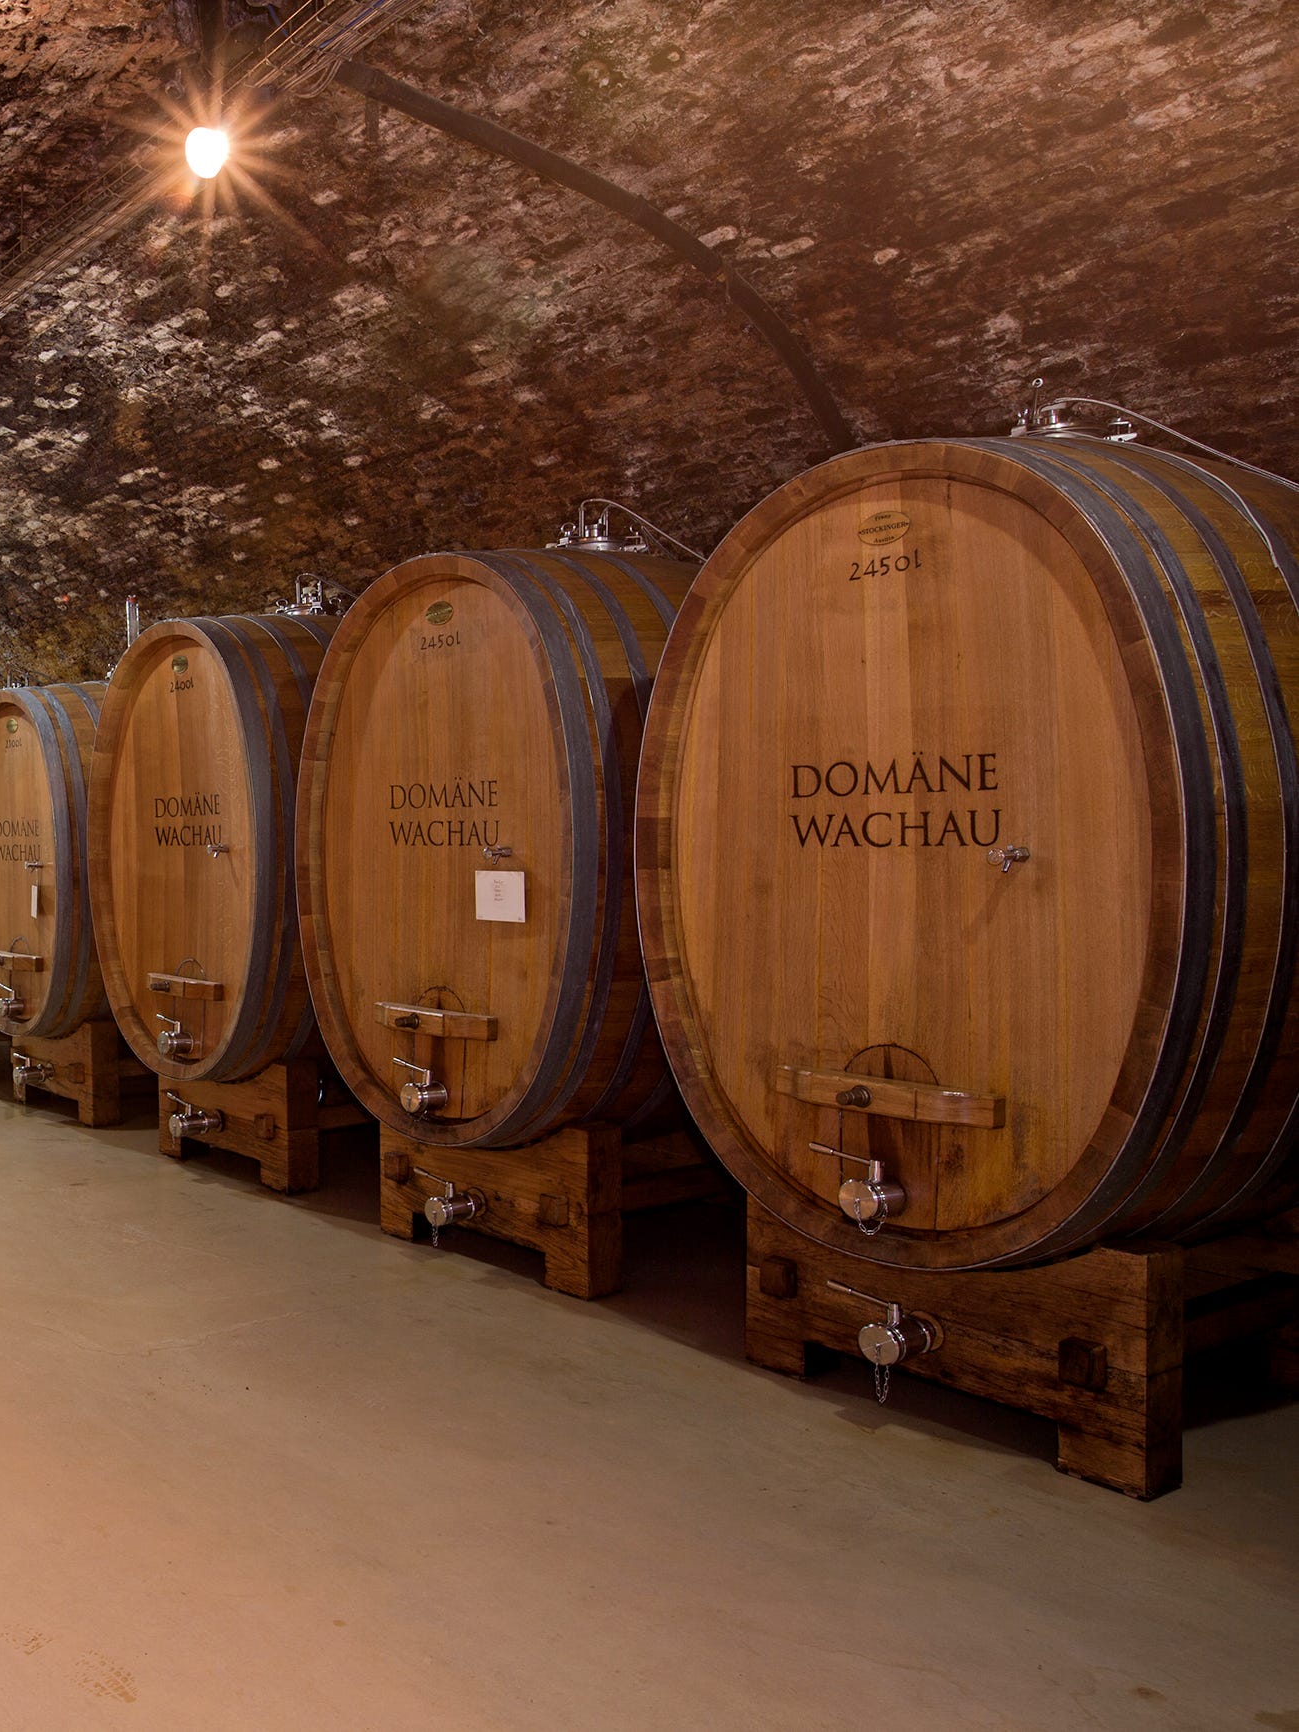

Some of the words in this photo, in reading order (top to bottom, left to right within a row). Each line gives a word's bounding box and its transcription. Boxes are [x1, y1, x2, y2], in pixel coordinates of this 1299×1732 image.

[861, 521, 906, 535] STOCKINGER
[790, 751, 999, 798] DOMÄNE
[154, 792, 221, 818] DOMÄNE
[389, 777, 498, 809] DOMÄNE
[155, 824, 222, 847] WACHAU
[388, 820, 500, 847] WACHAU
[789, 809, 1003, 848] WACHAU
